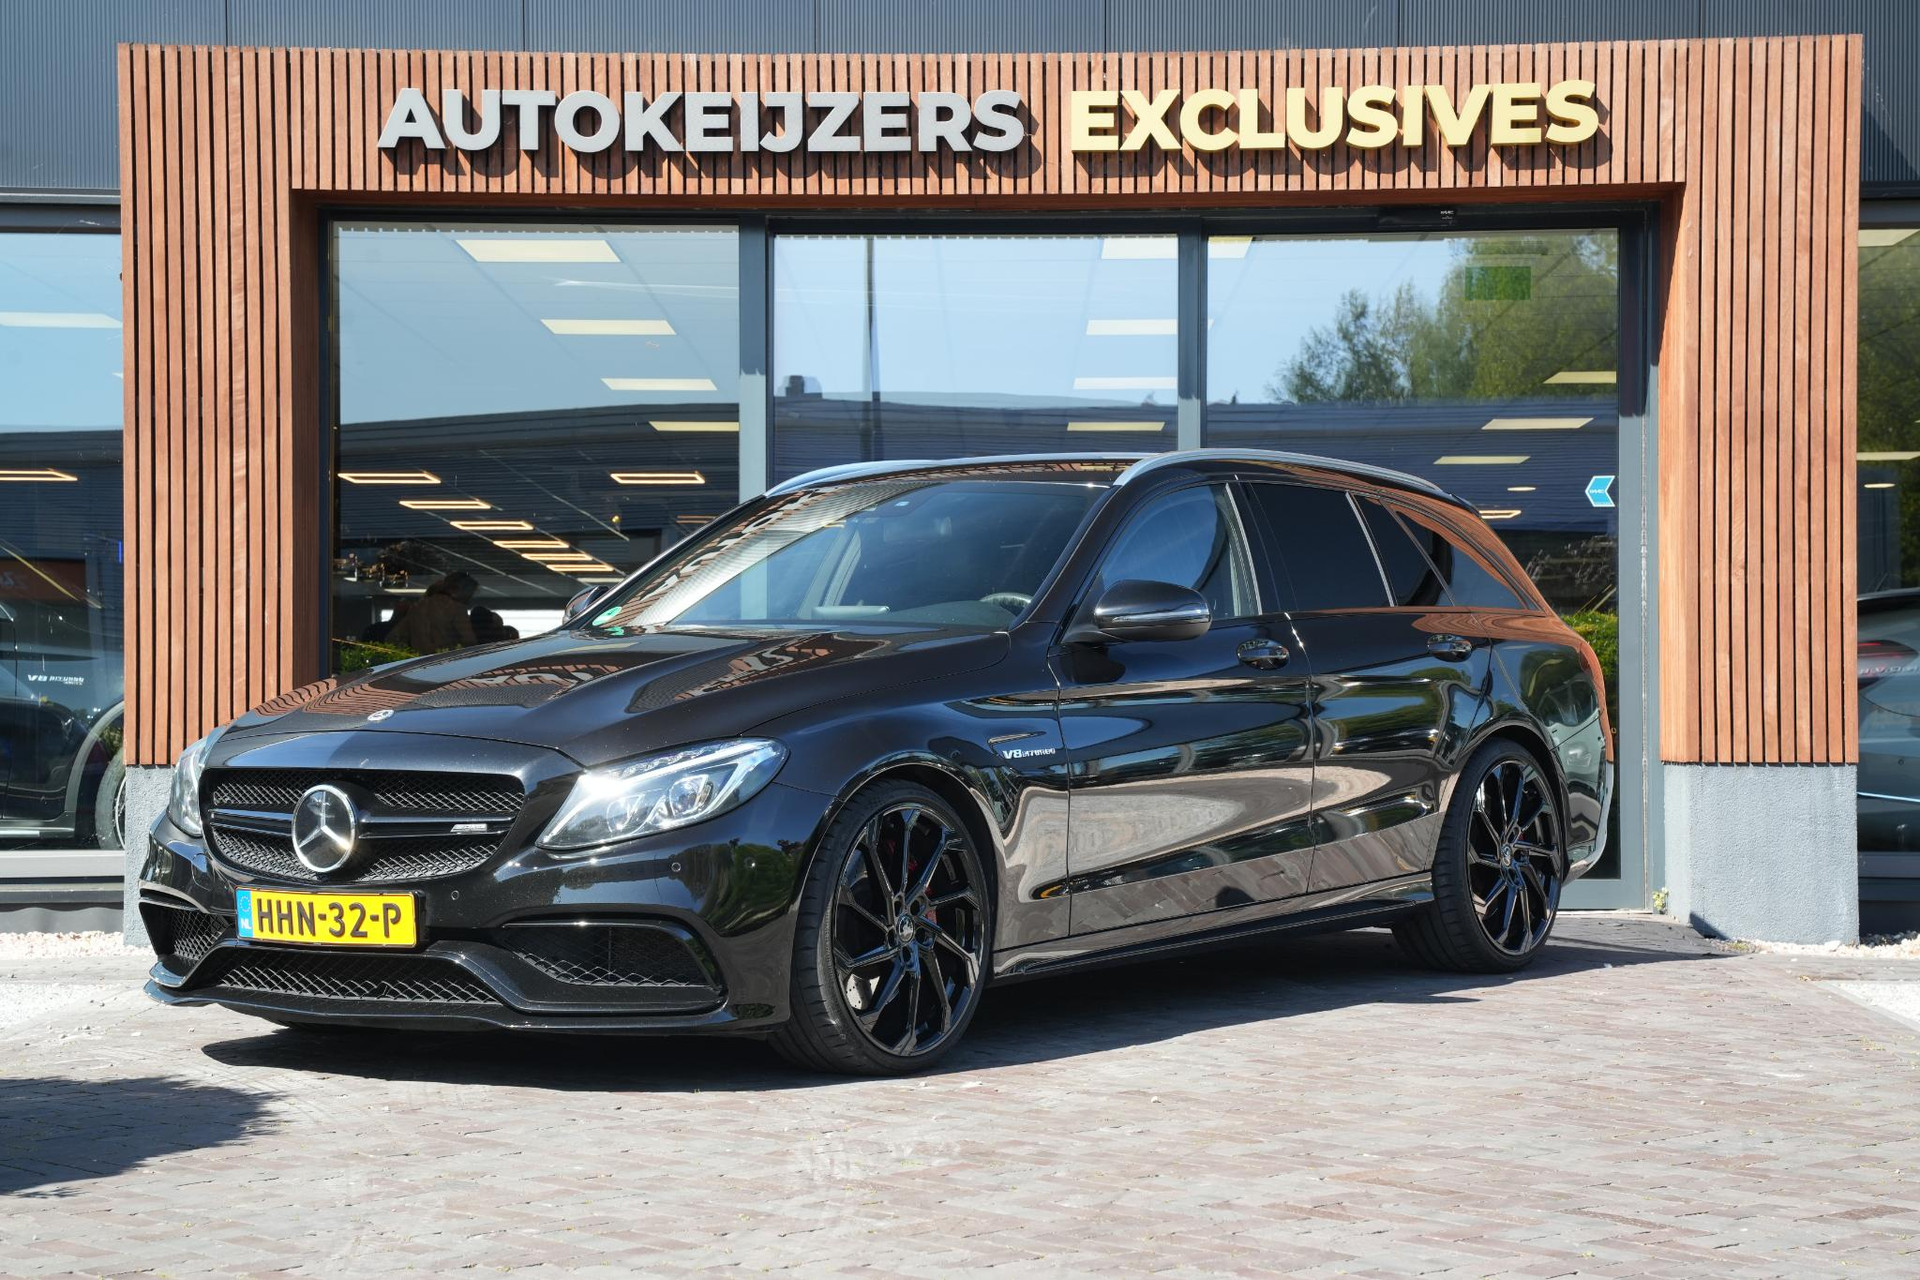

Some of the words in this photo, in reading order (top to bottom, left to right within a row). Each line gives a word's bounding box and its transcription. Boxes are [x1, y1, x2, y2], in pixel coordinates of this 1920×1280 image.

[377, 87, 1026, 154] AUTOKEIJZERS
[1070, 79, 1601, 152] EXCLUSIVES
[1003, 749, 1022, 759] V8
[240, 918, 252, 929] NL
[256, 898, 402, 939] HHN-32-P
